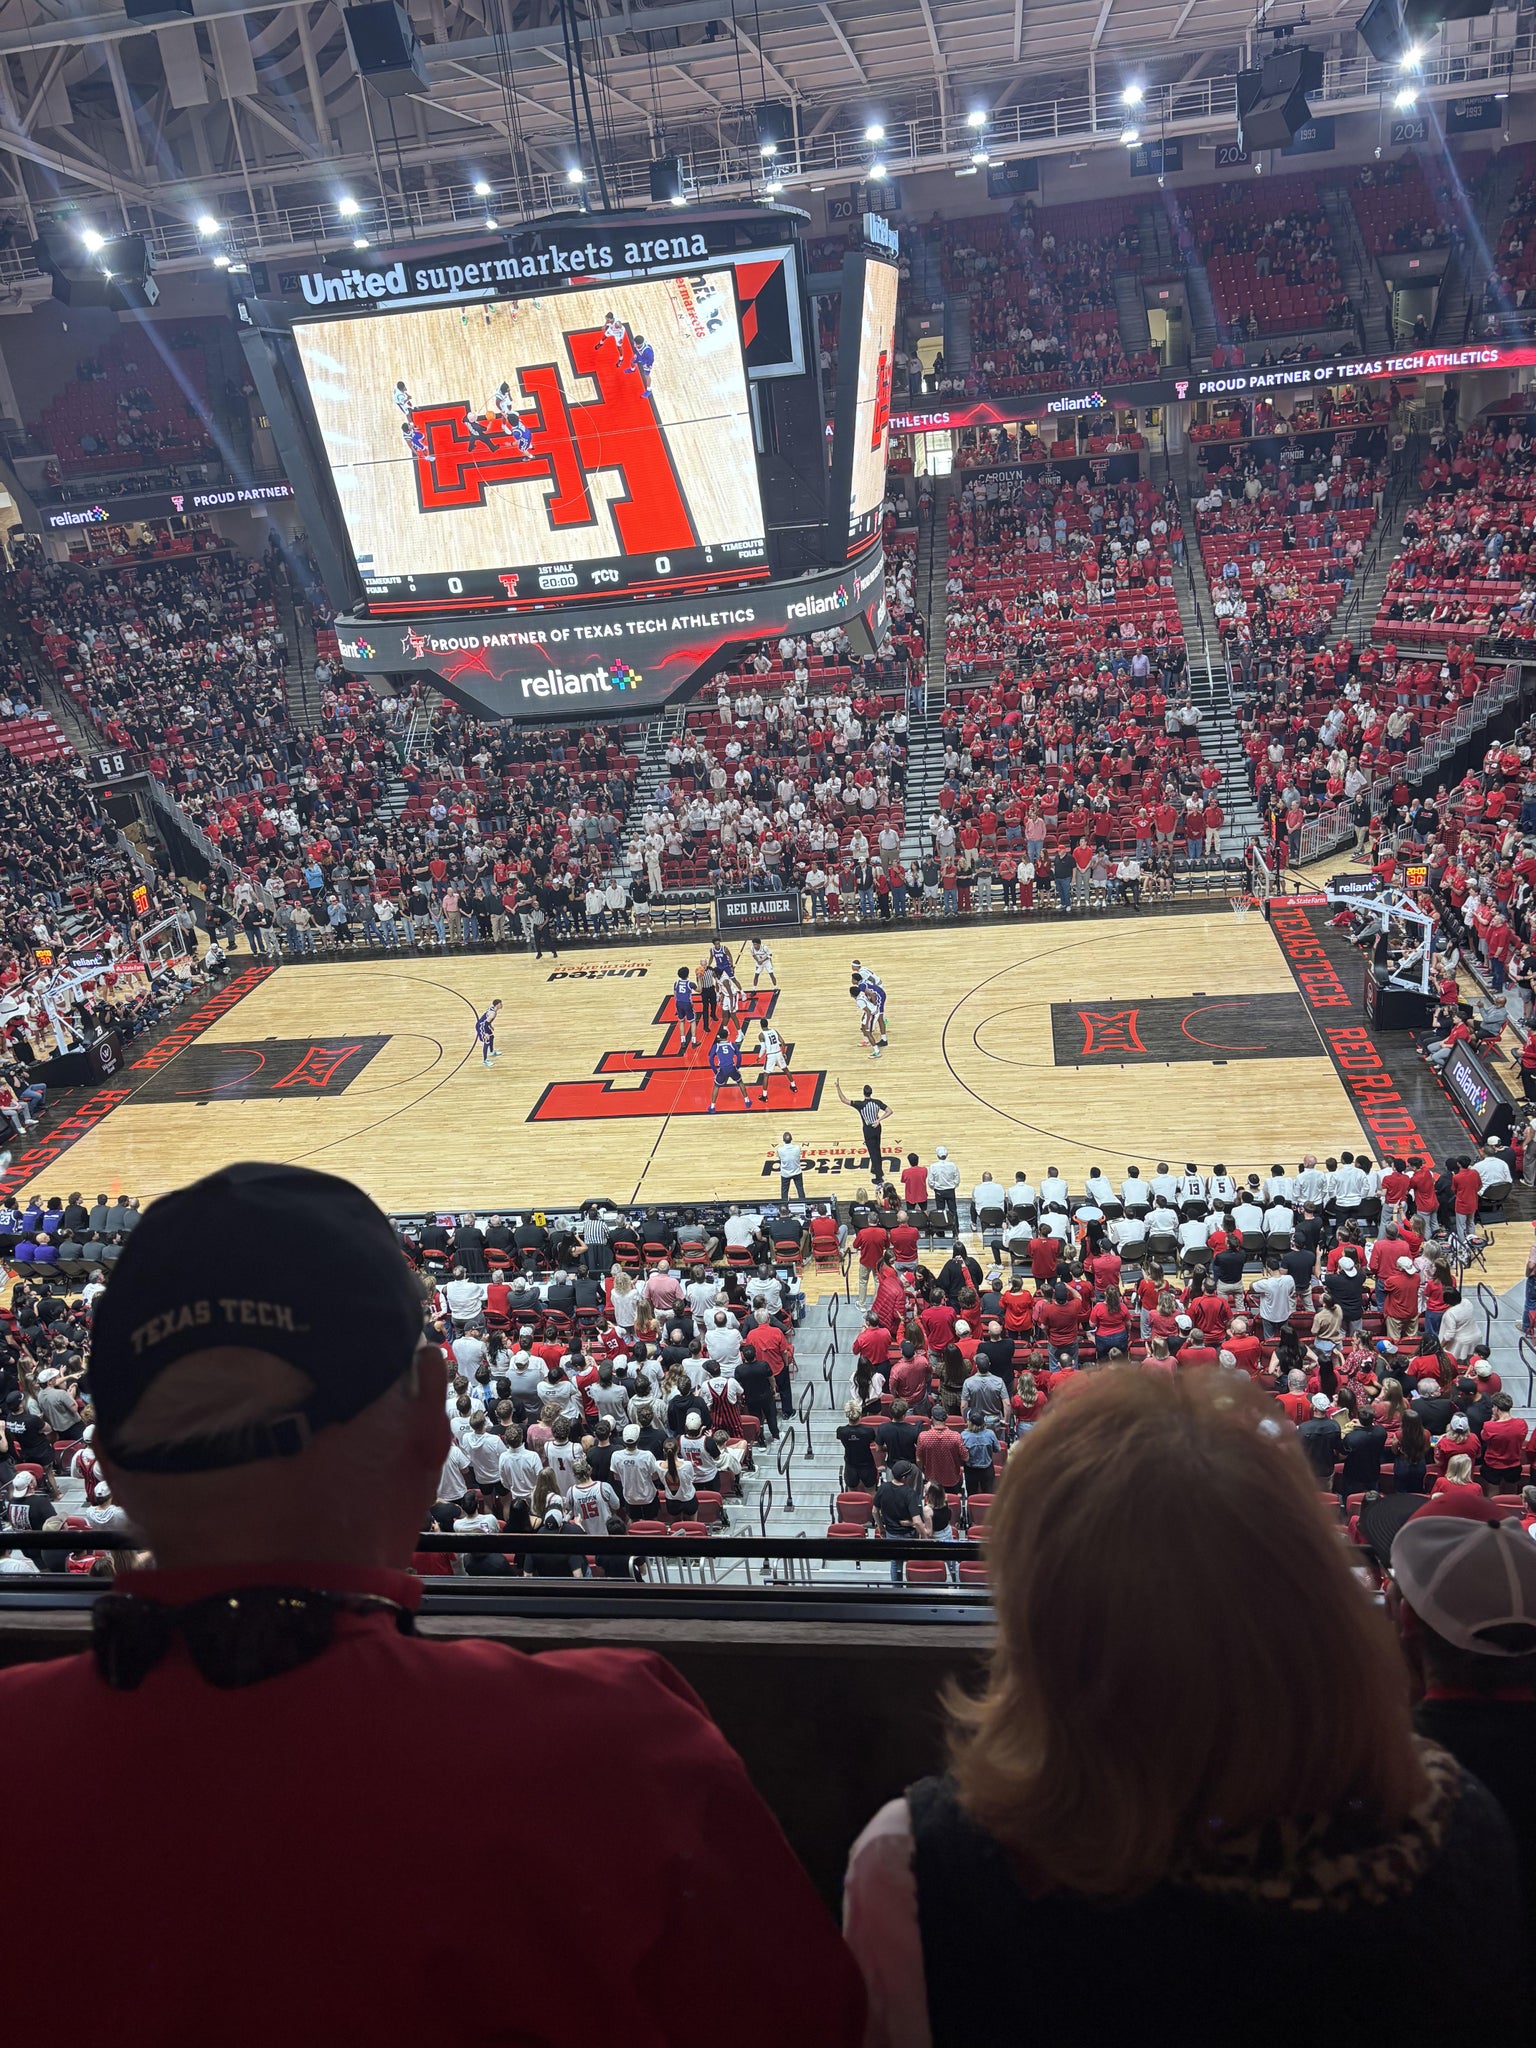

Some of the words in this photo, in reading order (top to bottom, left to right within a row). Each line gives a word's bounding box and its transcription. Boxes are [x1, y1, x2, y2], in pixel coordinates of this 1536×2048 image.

[1465, 106, 1482, 118] 1993
[1300, 128, 1316, 140] 1993
[1394, 122, 1424, 141] 204
[834, 201, 852, 218] 20
[301, 262, 408, 305] United
[415, 245, 613, 293] supermarkets
[624, 234, 708, 264] arena
[283, 274, 301, 291] 23
[676, 276, 706, 338] ermarkets
[1199, 378, 1246, 394] PROUD
[1249, 371, 1311, 388] PARTNER
[1314, 368, 1334, 380] OF
[1337, 361, 1382, 378] TEXAS
[1385, 356, 1423, 371] TECH
[1427, 350, 1499, 368] ATHLETICS
[1047, 395, 1092, 413] reliant
[888, 412, 950, 429] THLETICS
[978, 470, 1023, 484] CAROLYN
[193, 492, 235, 507] PROUD
[238, 487, 289, 501] PARTNER
[50, 509, 95, 527] reliant
[721, 539, 764, 552] TIMEOUTS
[706, 555, 713, 563] 0
[738, 549, 764, 559] FOULS
[538, 566, 552, 574] 1ST
[554, 563, 574, 573] HALF
[655, 556, 671, 574] 0
[364, 576, 402, 586] TIMEOUTS
[542, 576, 576, 588] 20:00
[591, 569, 620, 585] TCU
[366, 586, 389, 594] FOULS
[409, 584, 416, 592] 0
[448, 577, 463, 594] 0
[787, 592, 841, 619] reliant
[431, 636, 480, 651] PROUD
[483, 630, 548, 648] PARTNER
[551, 628, 571, 642] OF
[573, 623, 623, 640] TEXAS
[629, 619, 667, 635] TECH
[671, 608, 755, 630] ATHLETICS
[338, 638, 361, 659] iant
[521, 666, 612, 697] reliant
[99, 755, 125, 775] 68
[1406, 867, 1427, 876] 20:00
[1339, 882, 1375, 893] reliant
[1410, 875, 1423, 885] 30
[135, 895, 149, 914] 30
[726, 902, 748, 916] RED
[750, 900, 790, 914] RAIDER
[740, 915, 778, 923] BASKETBALL
[1271, 908, 1328, 959] TEXAS
[40, 957, 52, 965] 30
[72, 957, 99, 967] reliant
[553, 961, 653, 973] supermarkets
[547, 967, 649, 983] United
[678, 985, 687, 994] 15
[1295, 959, 1352, 1008] TECH
[128, 1033, 194, 1071] RED
[174, 965, 275, 1033] RAIDERS
[768, 1034, 777, 1045] 12
[722, 1045, 729, 1054] 5
[1325, 1026, 1384, 1070] RED
[1452, 1060, 1481, 1106] reliant
[39, 1088, 132, 1145] TECH
[1347, 1073, 1438, 1172] RAIDER
[766, 1146, 903, 1159] suermarks
[761, 1156, 902, 1176] United
[1189, 1183, 1200, 1195] 13
[1218, 1182, 1226, 1193] 5
[0, 1215, 11, 1225] 23
[130, 1299, 211, 1355] TEXAS
[218, 1298, 294, 1332] TECH
[606, 1339, 618, 1349] 23
[558, 1457, 566, 1471] 1
[685, 1452, 703, 1468] 15
[580, 1502, 599, 1520] 15
